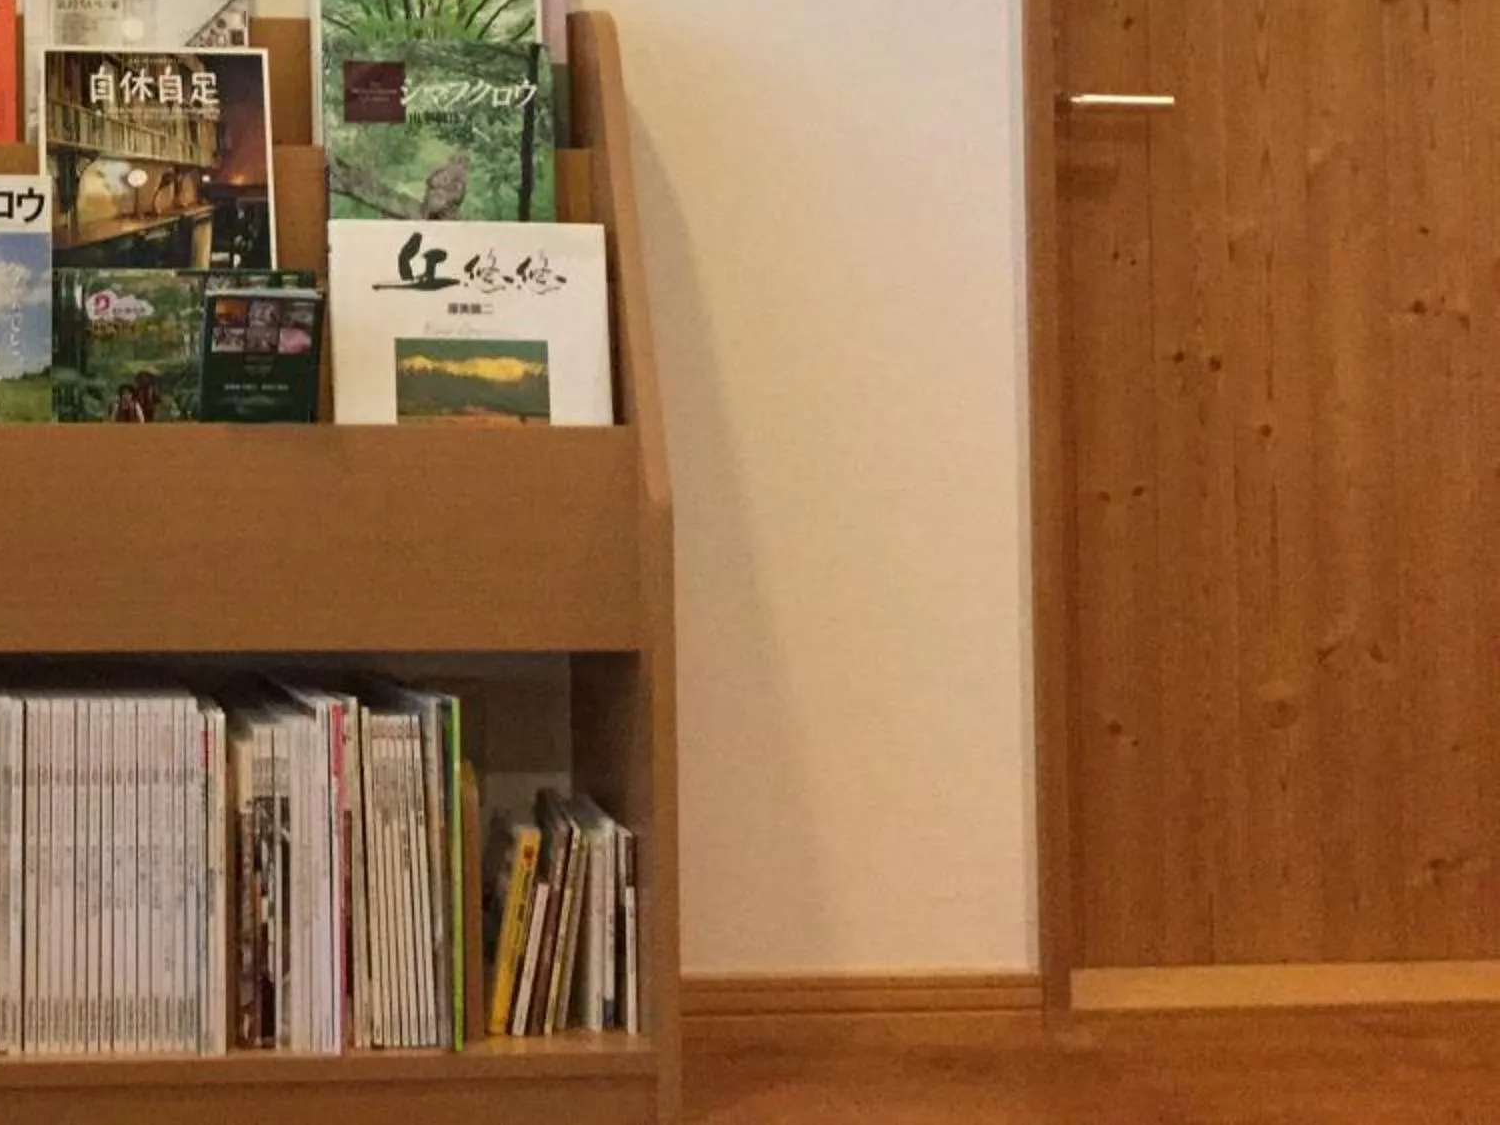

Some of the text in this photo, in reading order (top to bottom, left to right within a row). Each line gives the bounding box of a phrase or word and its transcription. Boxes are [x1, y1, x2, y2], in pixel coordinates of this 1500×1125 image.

[90, 65, 221, 104] 自休自足
[400, 76, 537, 108] シマフクロウ
